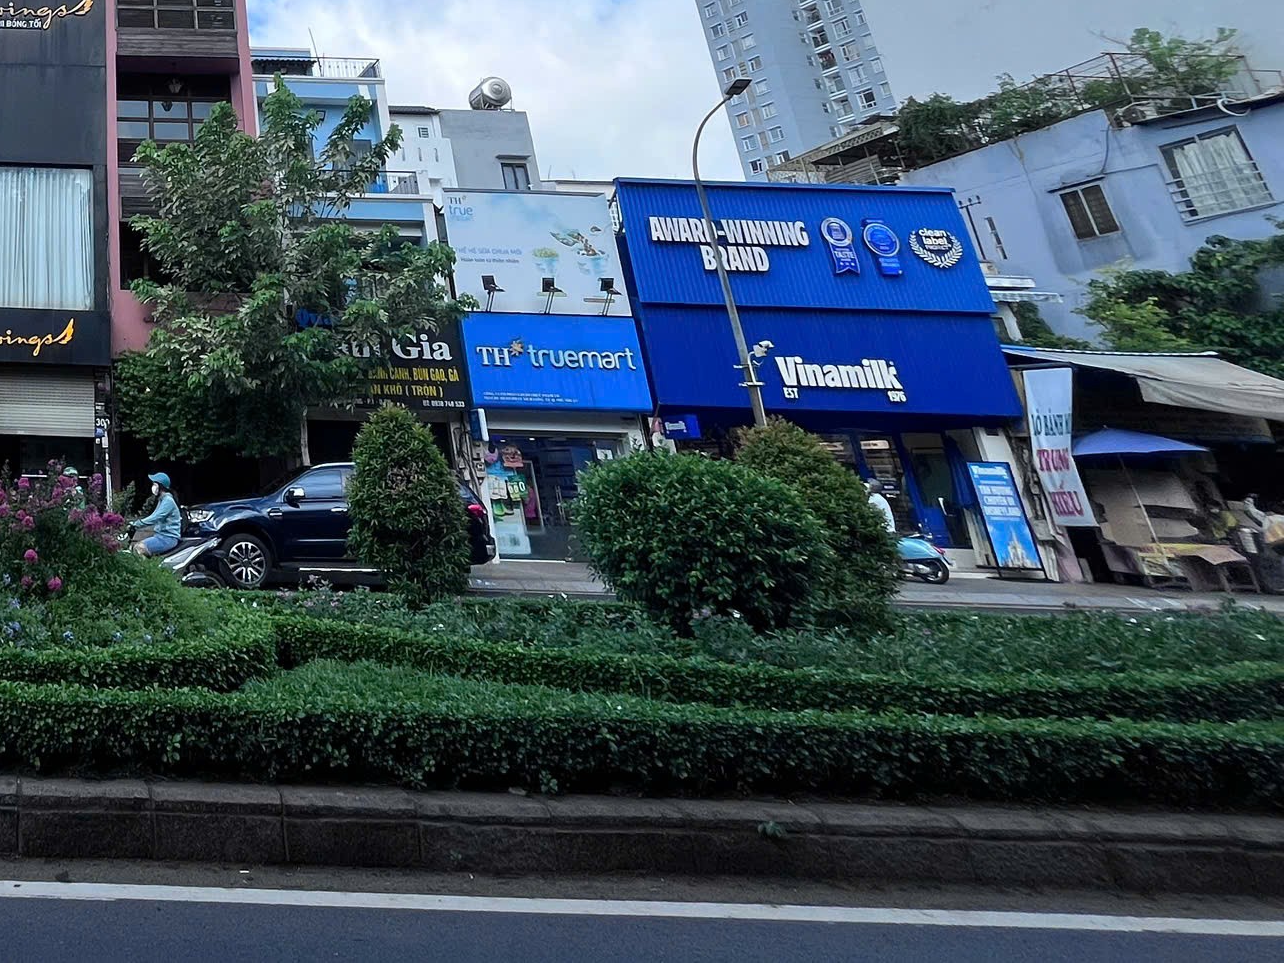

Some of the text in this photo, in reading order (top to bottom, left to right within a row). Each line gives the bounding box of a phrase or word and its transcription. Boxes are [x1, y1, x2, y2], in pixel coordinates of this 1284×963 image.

[448, 205, 473, 215] true
[918, 227, 947, 237] clean
[922, 236, 949, 245] label
[700, 244, 770, 272] BRAND
[391, 333, 453, 361] Gia
[476, 344, 637, 370] TH truemart
[774, 356, 904, 390] Vinamilk
[783, 387, 799, 398] EST
